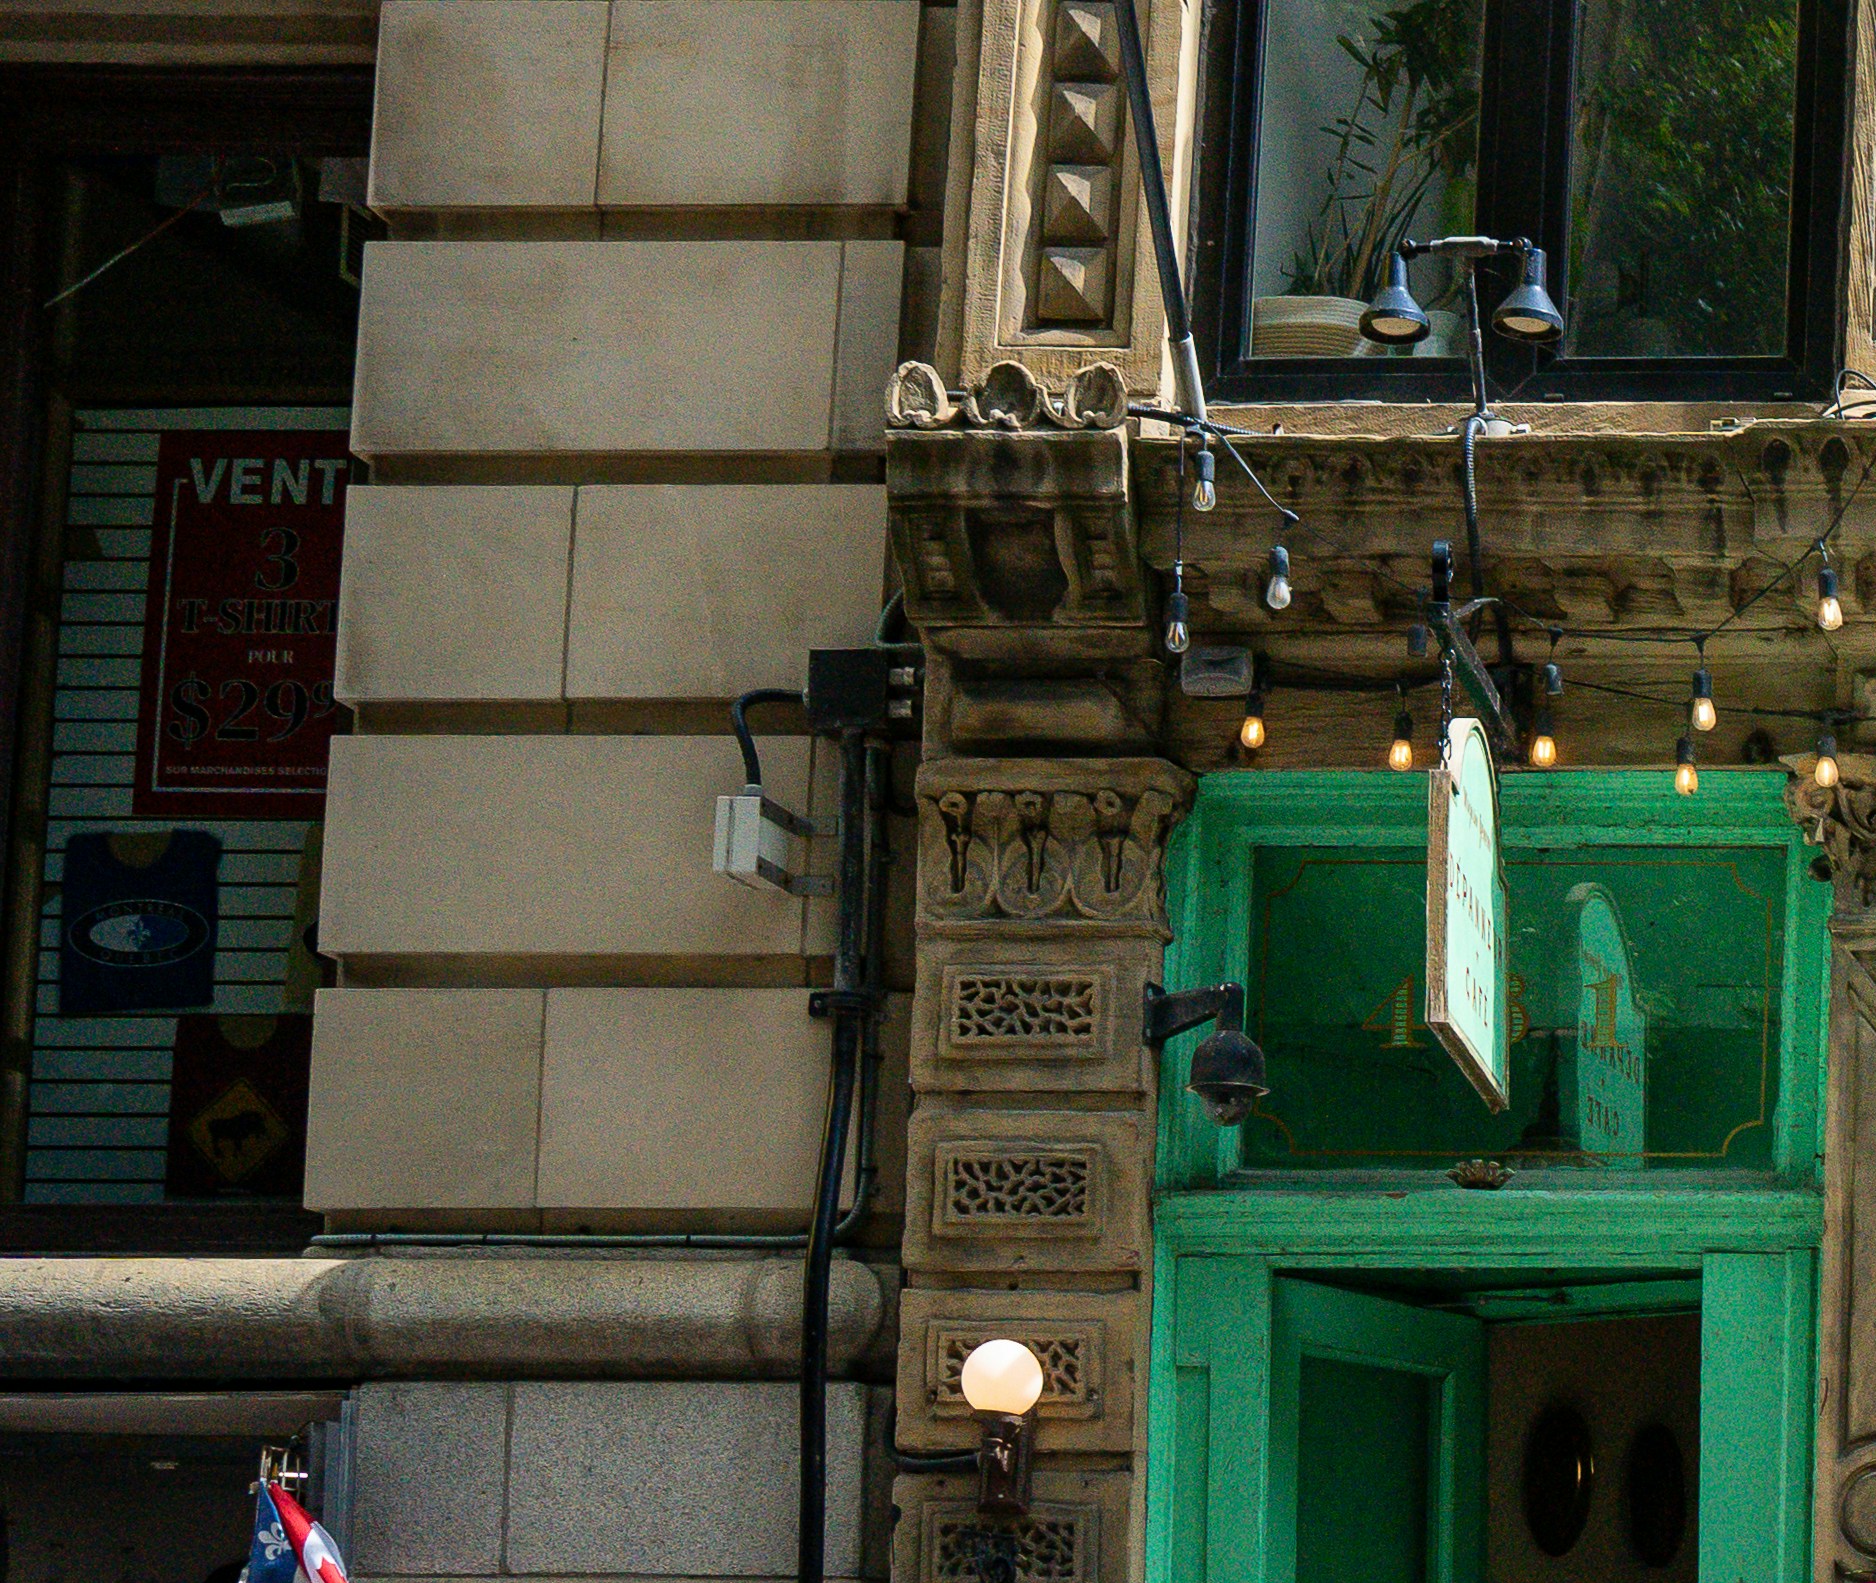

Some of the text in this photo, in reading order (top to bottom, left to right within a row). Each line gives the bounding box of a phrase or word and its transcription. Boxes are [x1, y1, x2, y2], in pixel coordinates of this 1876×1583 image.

[254, 526, 301, 591] 3
[247, 648, 295, 664] POUR
[165, 765, 188, 776] SUR
[190, 765, 275, 777] MARCHANDISES
